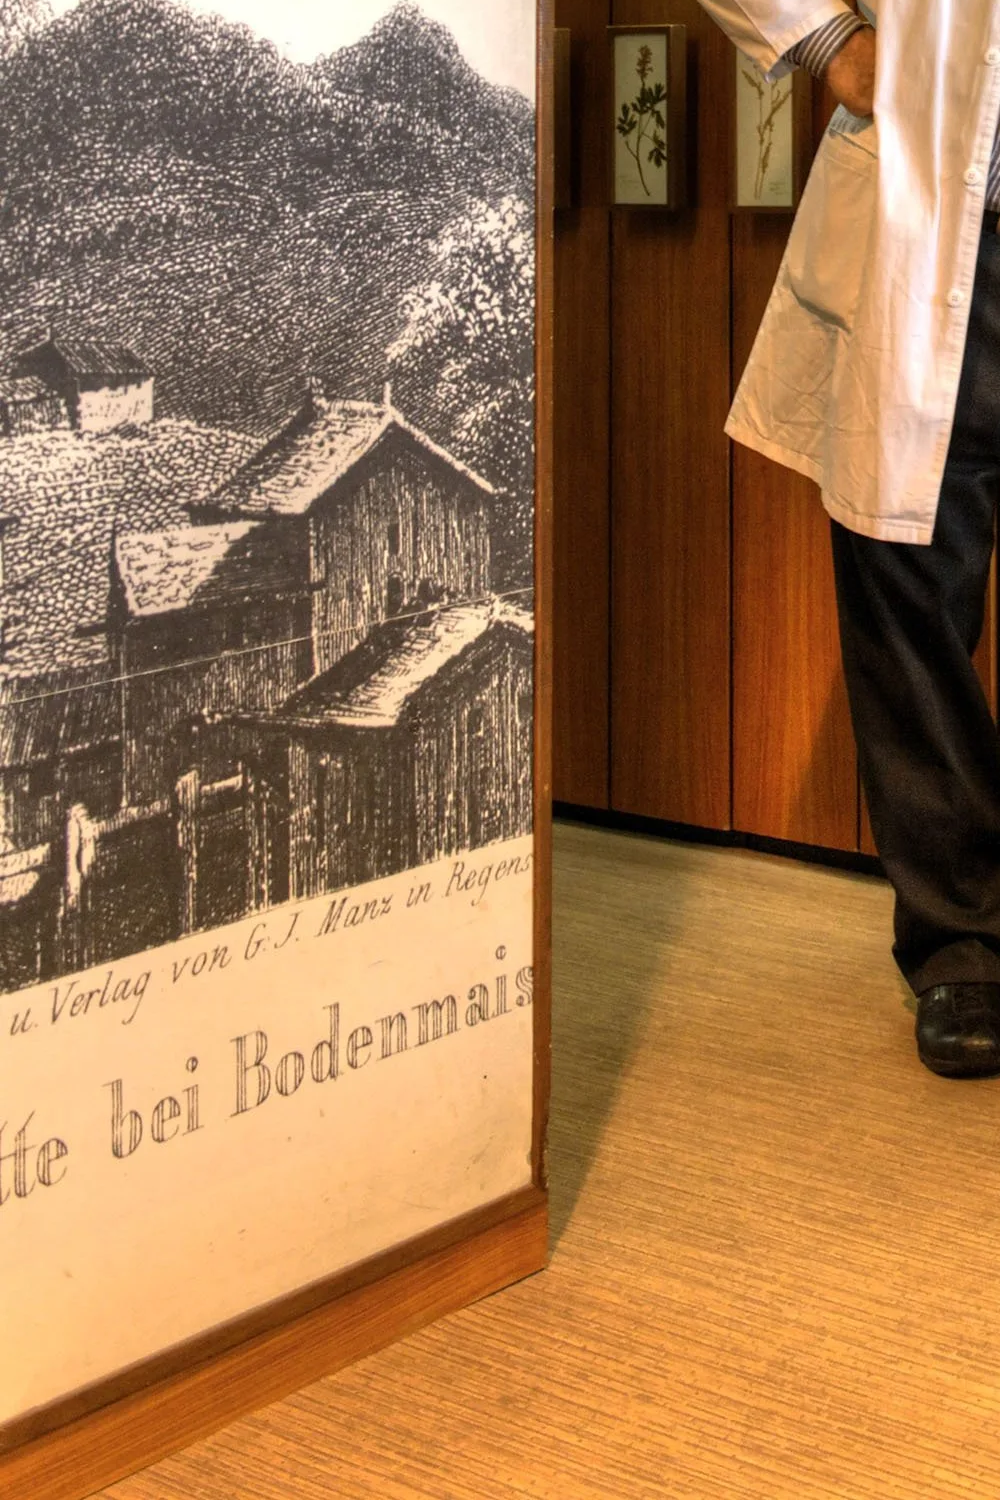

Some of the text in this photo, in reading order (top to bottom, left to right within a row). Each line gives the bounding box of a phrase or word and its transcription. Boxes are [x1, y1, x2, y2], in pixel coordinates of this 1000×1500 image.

[9, 1007, 39, 1036] u.
[50, 970, 152, 1025] Verlag
[171, 944, 232, 984] von
[313, 896, 394, 938] Manz
[406, 880, 433, 909] in
[444, 853, 534, 907] Regens
[102, 1055, 205, 1160] bei
[229, 944, 534, 1118] Bodenmais
